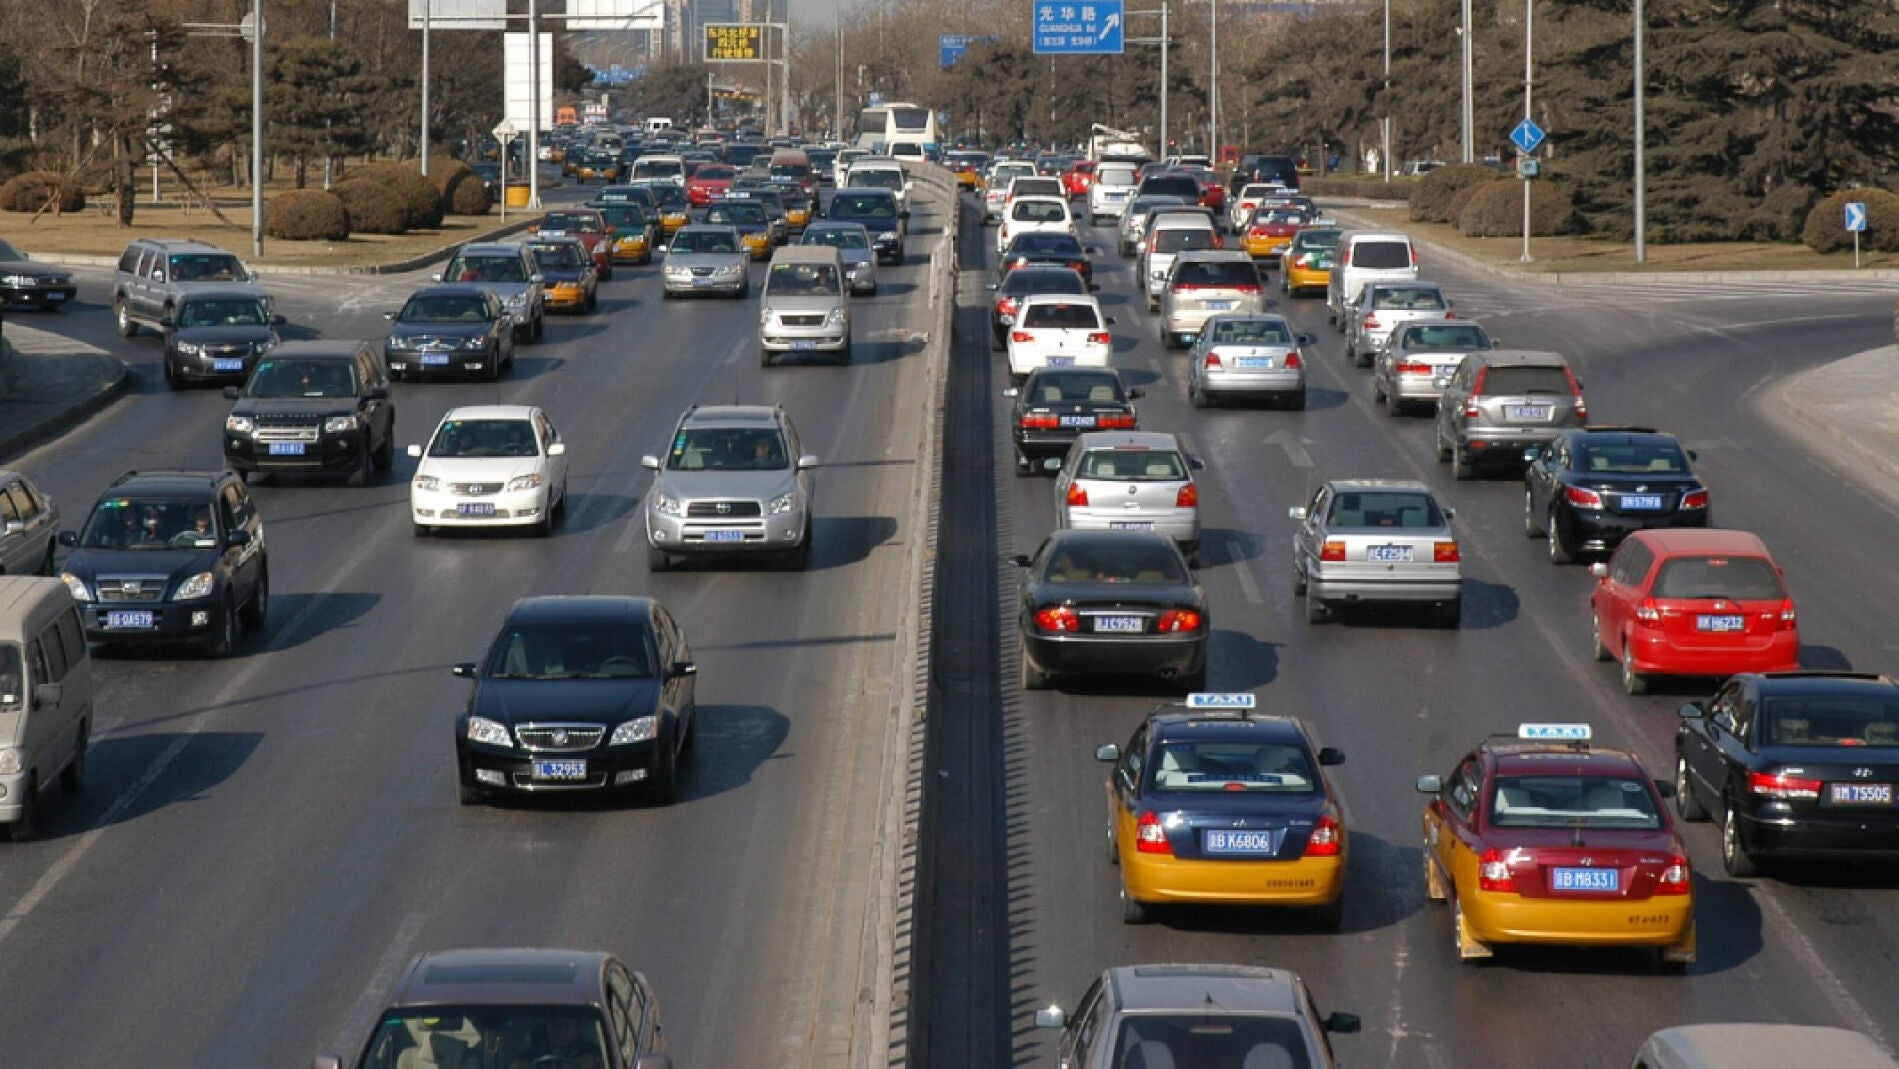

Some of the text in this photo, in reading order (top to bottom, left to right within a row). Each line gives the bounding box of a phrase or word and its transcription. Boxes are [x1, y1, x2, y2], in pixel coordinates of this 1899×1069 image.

[1039, 6, 1096, 21] 光华路
[1196, 694, 1250, 706] TAXI
[1527, 726, 1585, 737] TAXI
